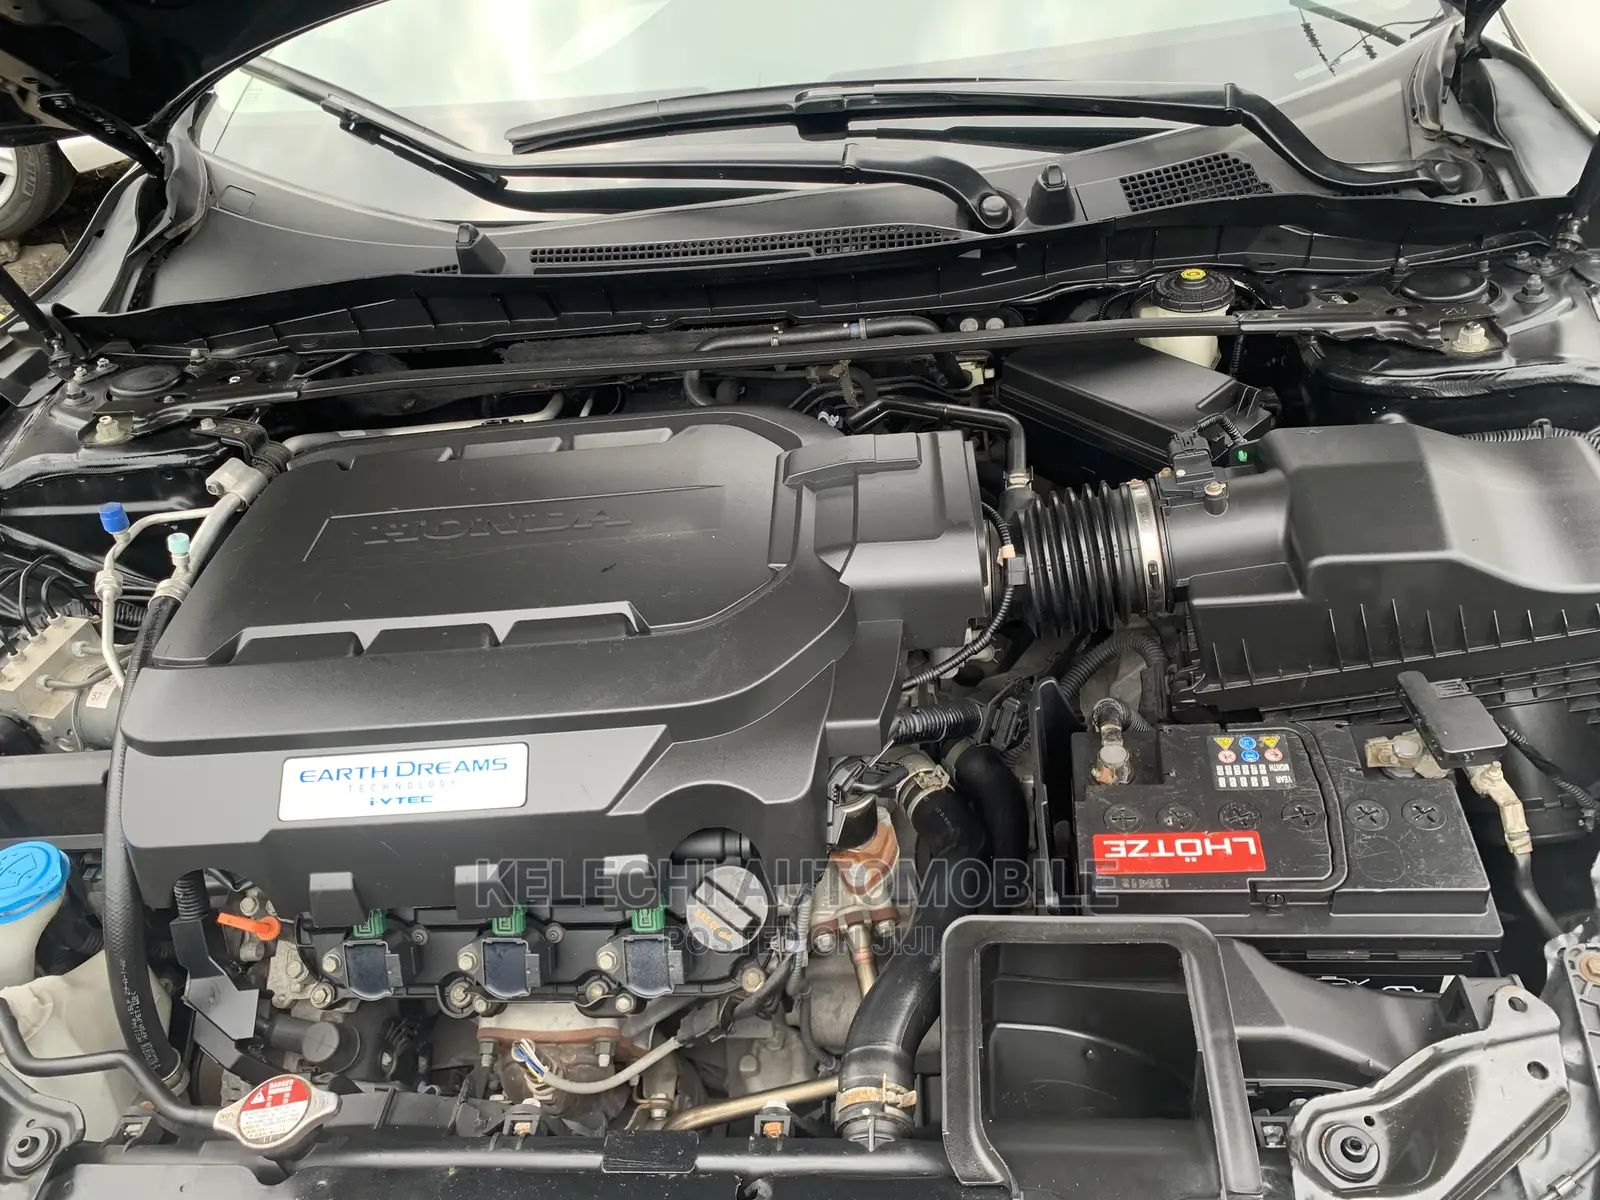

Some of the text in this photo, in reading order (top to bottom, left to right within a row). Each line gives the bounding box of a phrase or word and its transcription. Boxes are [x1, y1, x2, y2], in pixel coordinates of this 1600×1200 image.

[364, 509, 632, 545] HONDA
[299, 757, 508, 783] EARTH DREAMS
[348, 779, 457, 793] TECHNOLOGY
[1103, 837, 1257, 862] LHÖTZE
[695, 908, 712, 924] SAE
